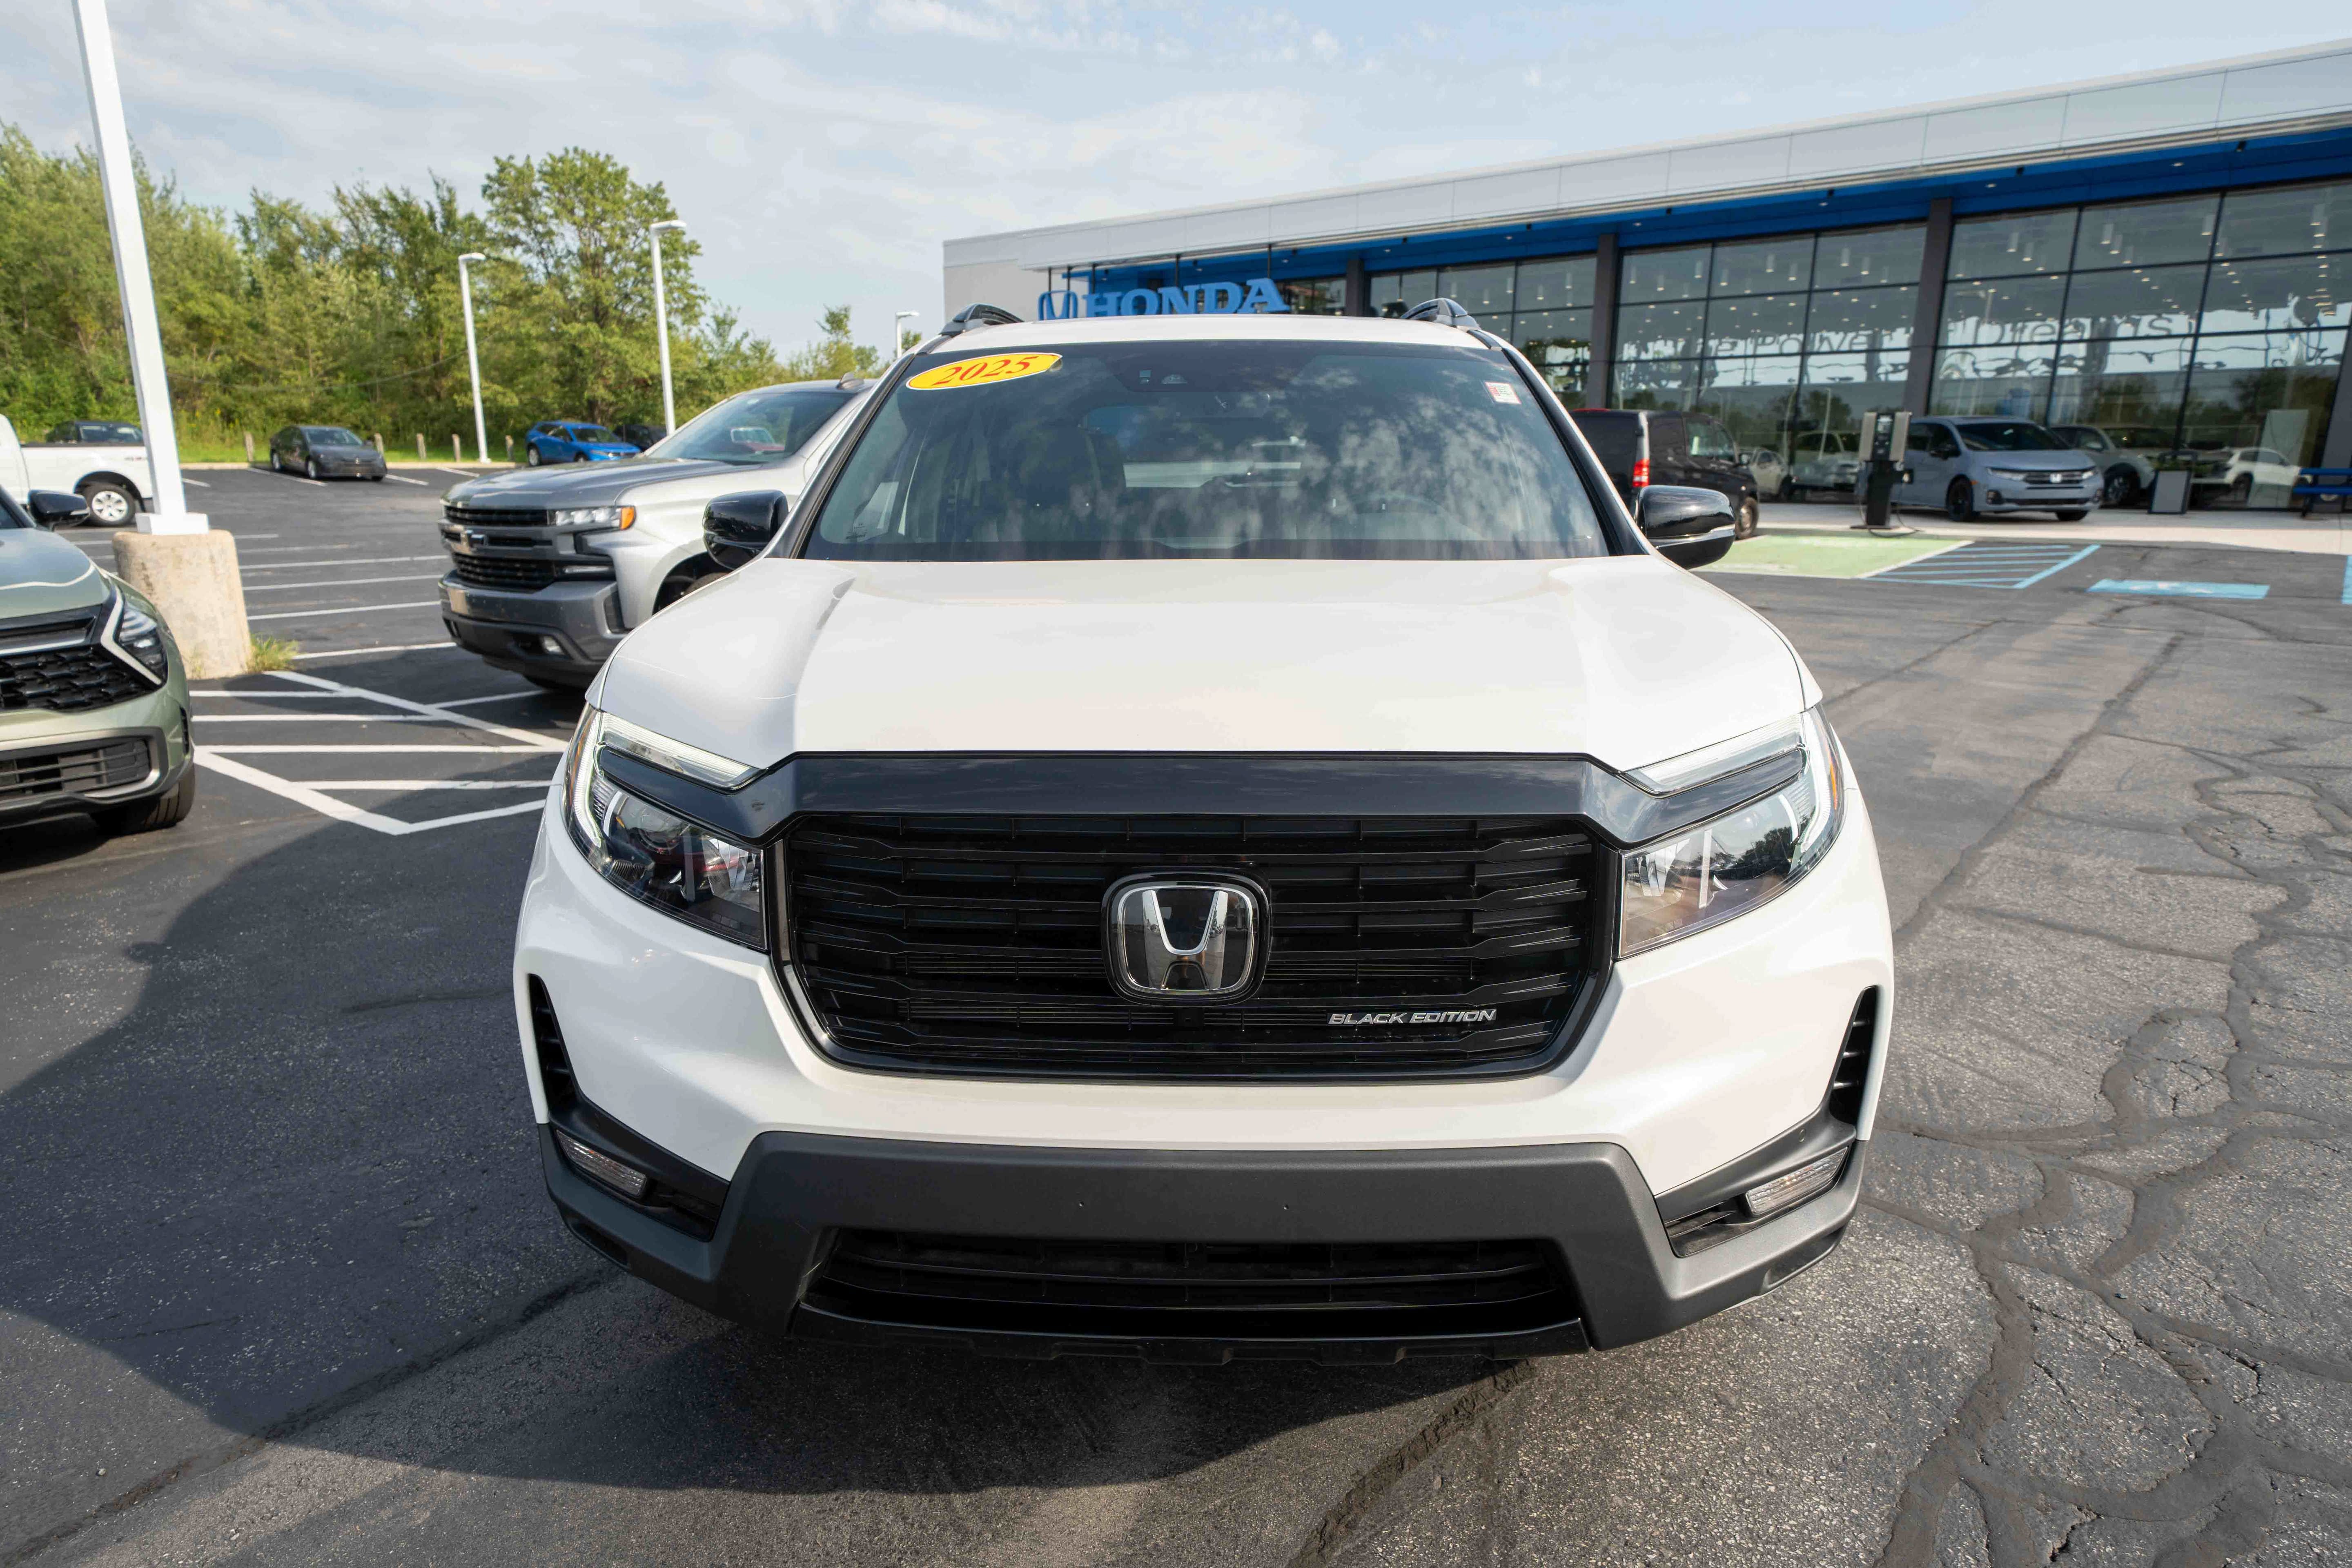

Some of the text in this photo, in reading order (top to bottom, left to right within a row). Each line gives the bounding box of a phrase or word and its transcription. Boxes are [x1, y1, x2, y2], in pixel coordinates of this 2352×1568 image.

[1082, 278, 1290, 318] HONDA
[931, 356, 1039, 386] 2025
[1328, 1009, 1496, 1024] BLACK EDITION
